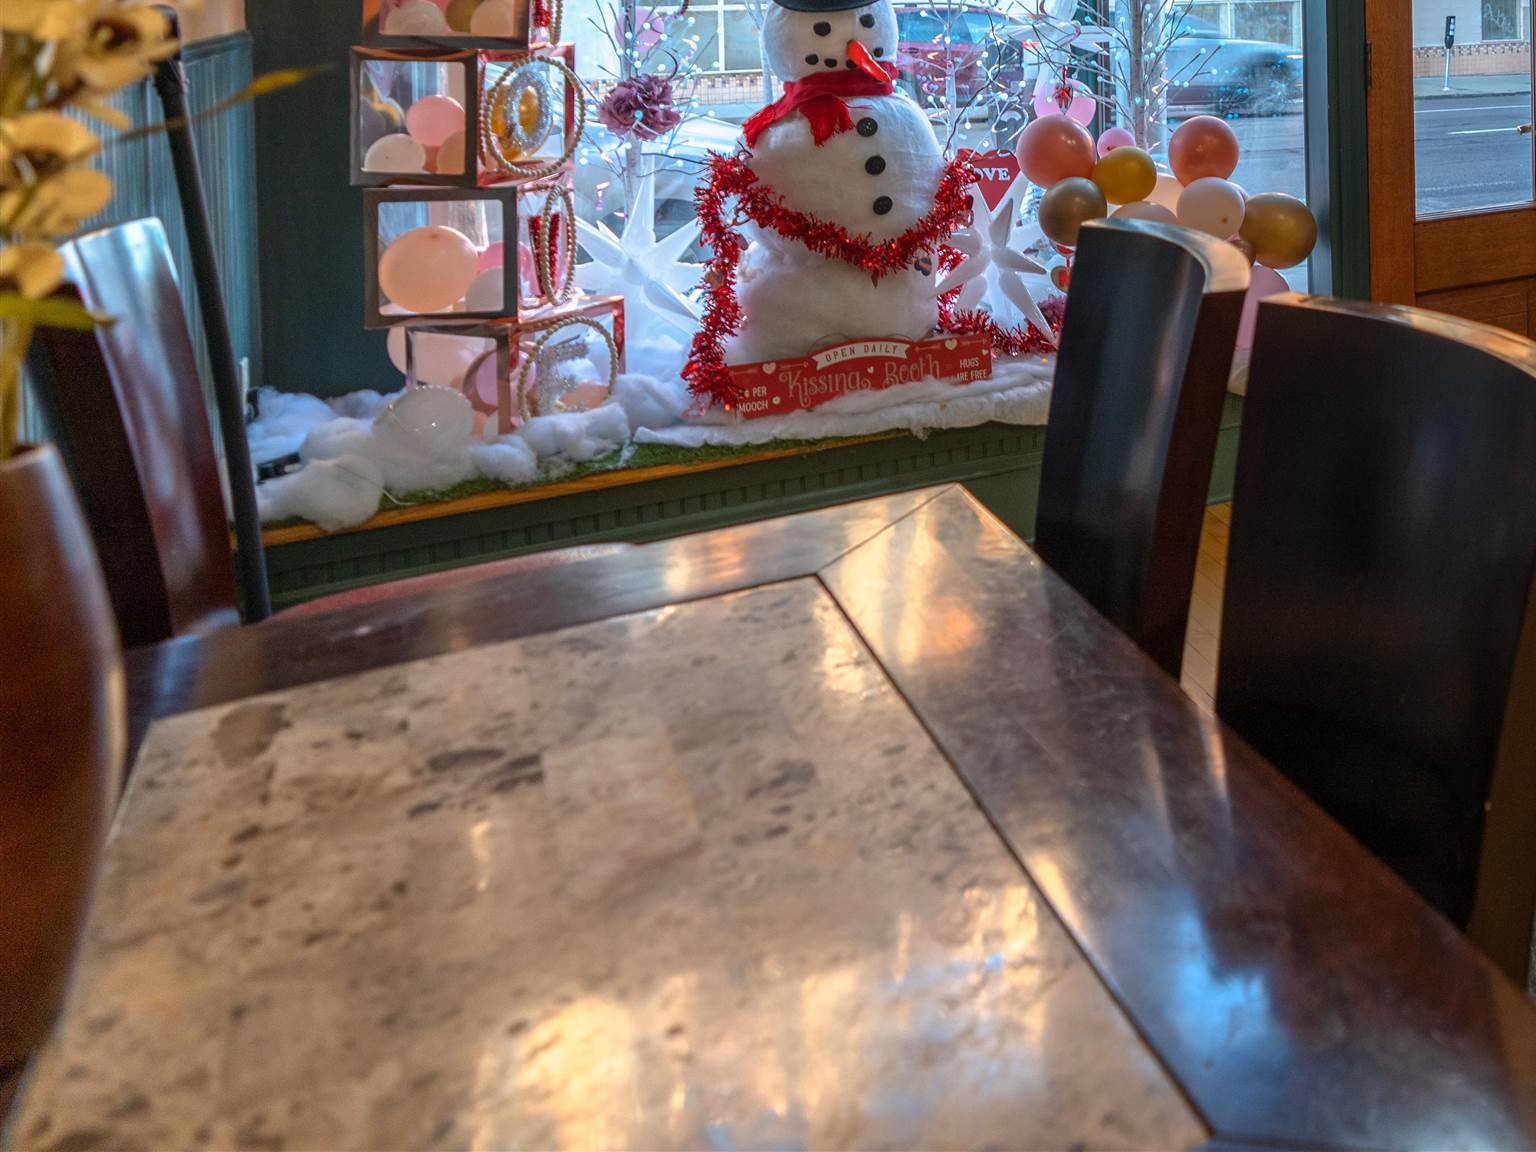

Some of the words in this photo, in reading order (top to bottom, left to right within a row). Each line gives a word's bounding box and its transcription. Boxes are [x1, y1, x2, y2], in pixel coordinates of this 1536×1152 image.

[974, 167, 1010, 181] OVE
[825, 346, 856, 362] OPEN
[863, 343, 898, 355] DAILY
[959, 357, 980, 368] HUGS
[882, 353, 940, 389] Booth
[970, 369, 988, 380] FREE
[752, 385, 768, 398] PER
